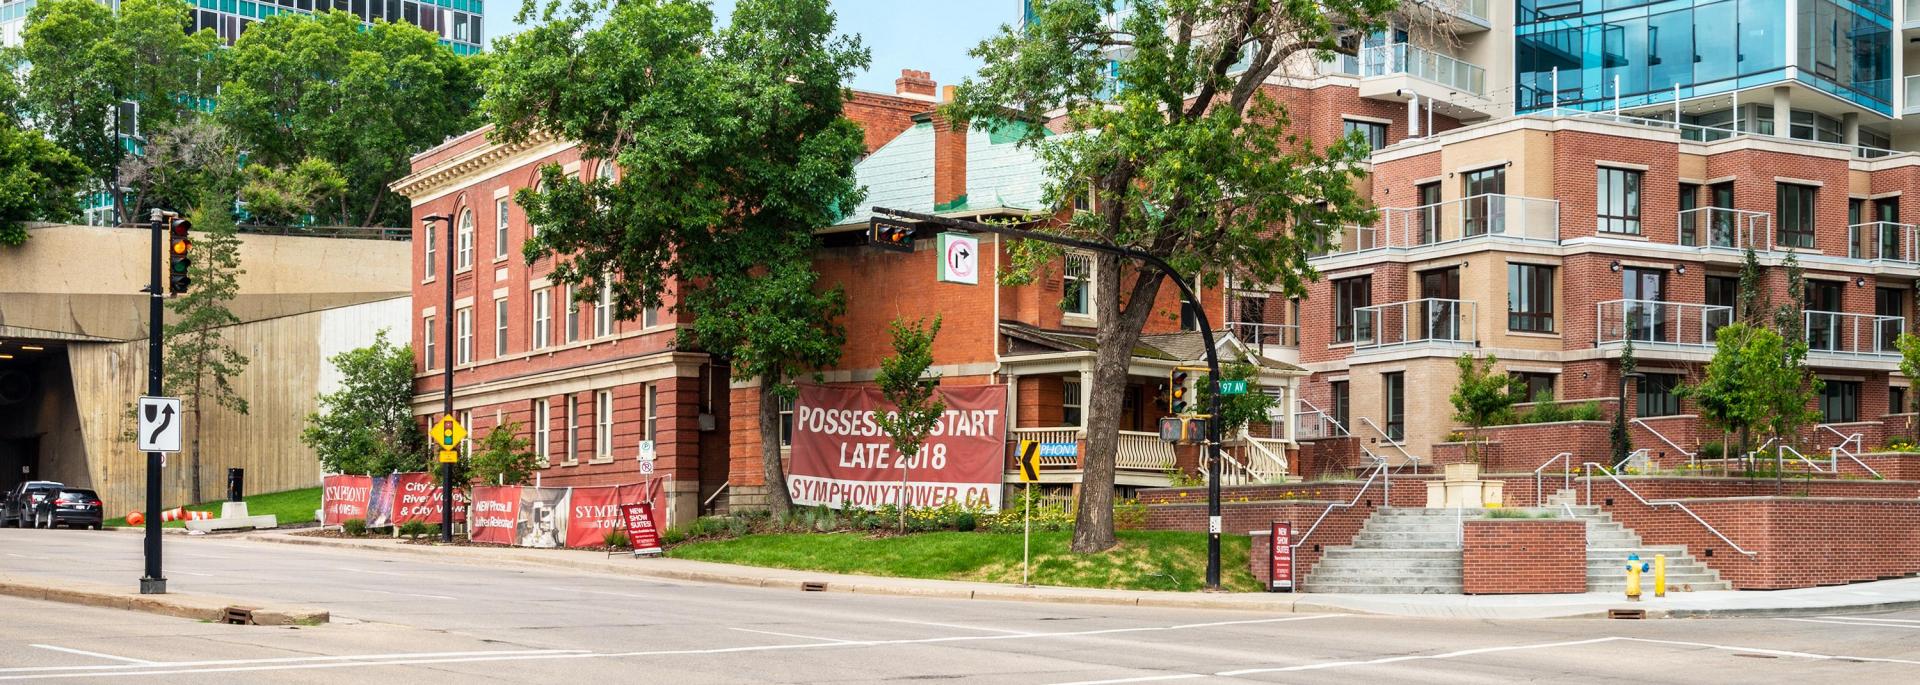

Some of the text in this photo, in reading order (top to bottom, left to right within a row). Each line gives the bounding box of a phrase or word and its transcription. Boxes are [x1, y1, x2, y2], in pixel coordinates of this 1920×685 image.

[1222, 382, 1244, 393] 97 AV
[929, 409, 999, 437] START
[839, 442, 947, 470] LATE 2018
[405, 481, 435, 492] City's
[400, 507, 409, 516] &
[412, 506, 433, 516] City
[596, 519, 627, 528] TOWE
[629, 514, 648, 522] SHOW
